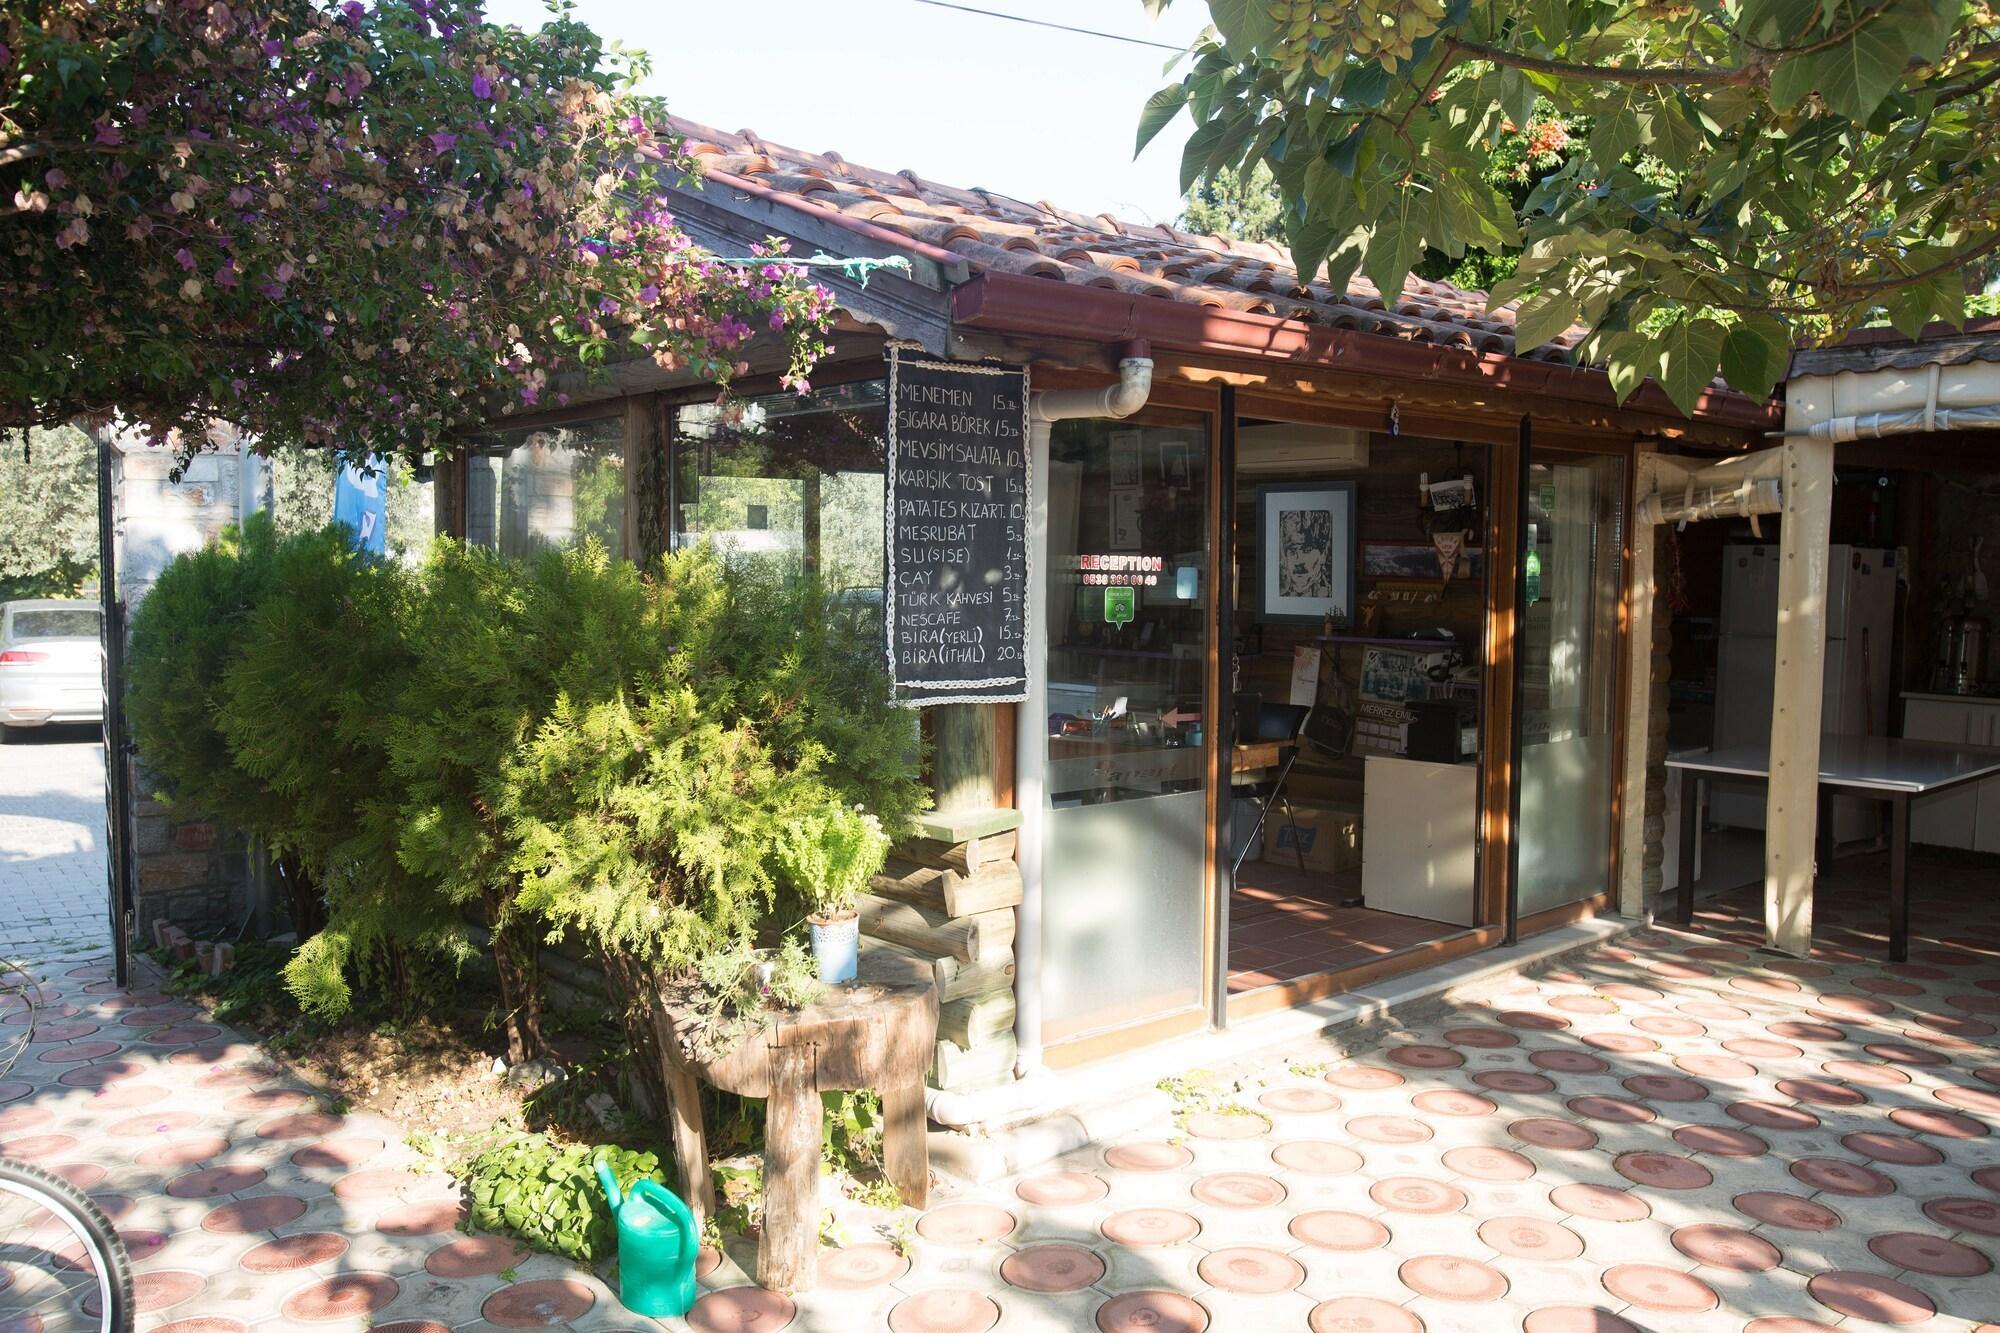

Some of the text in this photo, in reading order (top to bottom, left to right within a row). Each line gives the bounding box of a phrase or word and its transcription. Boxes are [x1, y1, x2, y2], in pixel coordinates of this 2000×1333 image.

[900, 383, 972, 407] MENEMEN
[898, 407, 948, 431] SİGARA
[951, 411, 991, 436] BÖREK
[899, 468, 952, 491] KARIŞIK
[959, 473, 994, 493] TOST
[899, 499, 957, 519] PATATES
[899, 523, 977, 542] MEŞRUBAT
[1081, 555, 1161, 571] RECEPTION
[899, 570, 934, 588] ÇAY
[898, 591, 941, 607] TÜRK
[946, 586, 993, 605] KAHVESİ
[901, 611, 961, 626] NESCAFE
[1360, 703, 1394, 718] MERKEZ
